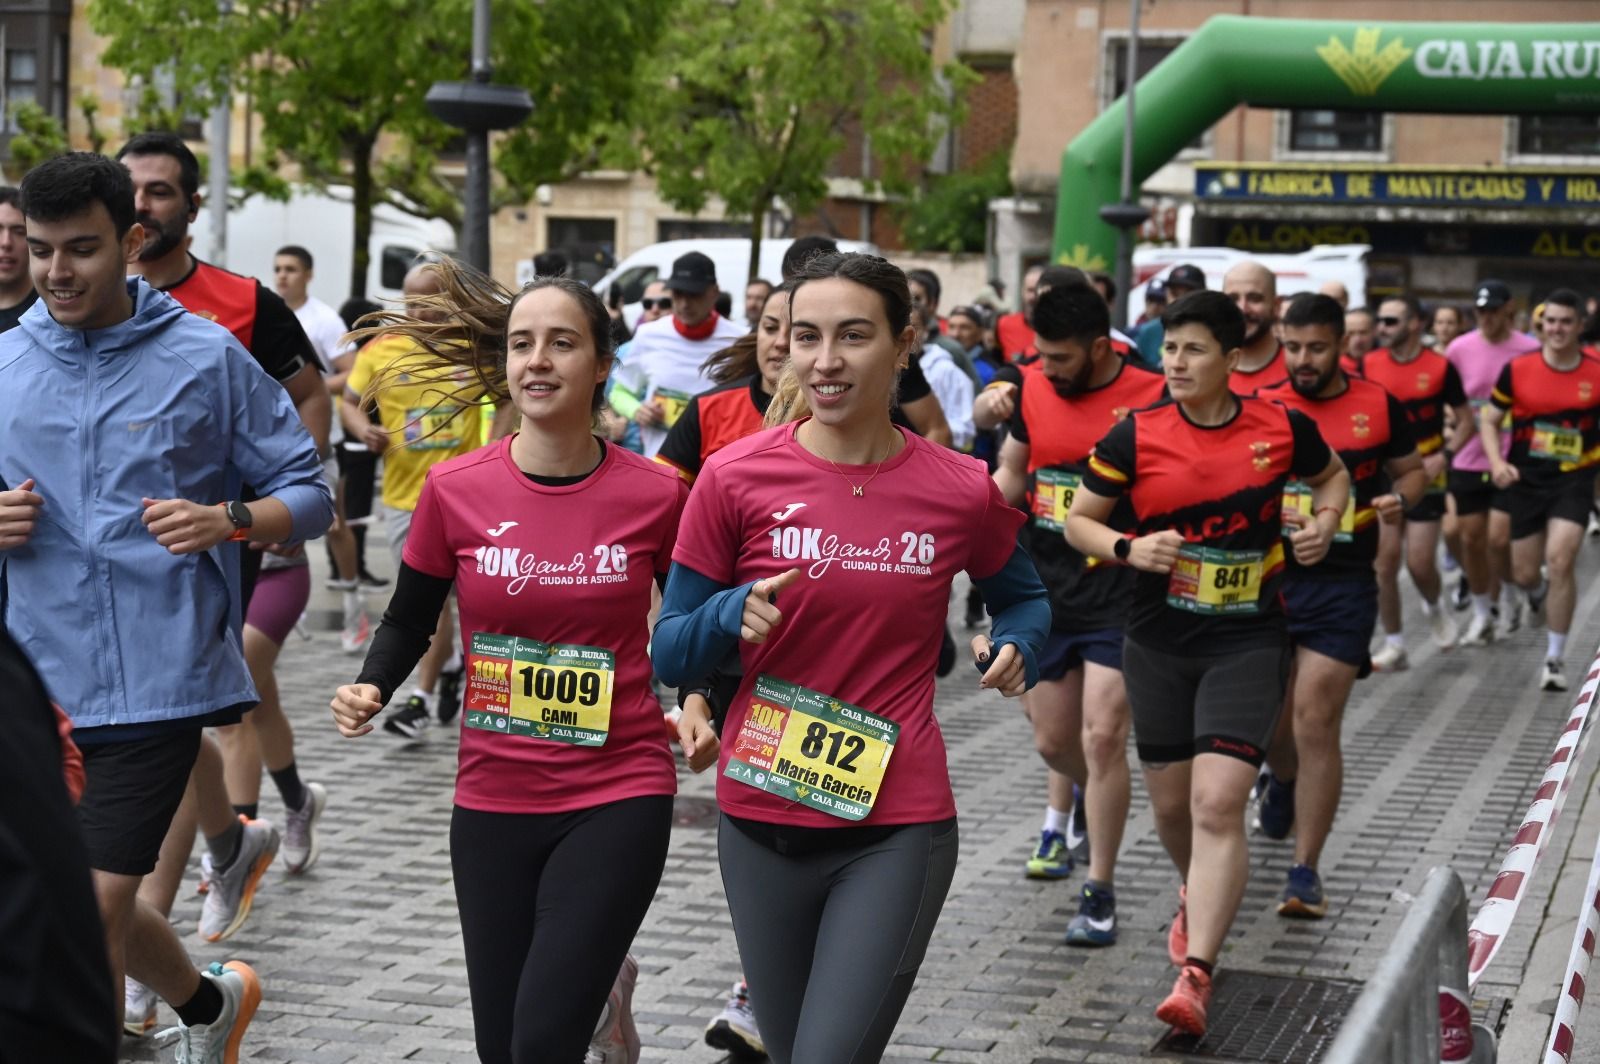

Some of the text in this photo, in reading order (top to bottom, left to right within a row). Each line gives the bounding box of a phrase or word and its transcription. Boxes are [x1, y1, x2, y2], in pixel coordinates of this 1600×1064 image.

[1414, 39, 1526, 80] CAJA
[1248, 172, 1334, 196] FABRICA
[1347, 174, 1373, 198] DE
[1387, 175, 1526, 200] MANTECADAS
[1539, 177, 1555, 200] Y
[1227, 222, 1370, 249] ALONSO
[768, 526, 823, 560] 10K
[475, 545, 521, 577] 10K
[841, 560, 932, 576] CIUDAD DE ASTORGA
[539, 573, 629, 585] CIUDAD DE ASTORGA
[1214, 566, 1249, 589] 841
[473, 642, 510, 654] Telenauto
[559, 649, 610, 660] CAJA RURAL
[471, 675, 498, 685] CIUDAD
[473, 660, 508, 681] 10K
[471, 681, 510, 694] ASTORGA
[519, 665, 601, 706] 1009
[756, 684, 791, 702] Telenauto
[805, 698, 824, 709] VEOLIA
[541, 707, 578, 726] CAMI
[752, 703, 786, 731] 10K
[841, 708, 894, 733] CAJA RURAL
[552, 728, 602, 742] CAJA RURAL
[741, 727, 779, 747] ASTORGA
[744, 719, 782, 738] CIUDAD DE
[801, 721, 866, 774] 812
[776, 757, 872, 805] María García
[811, 792, 864, 817] CAJA RURAL
